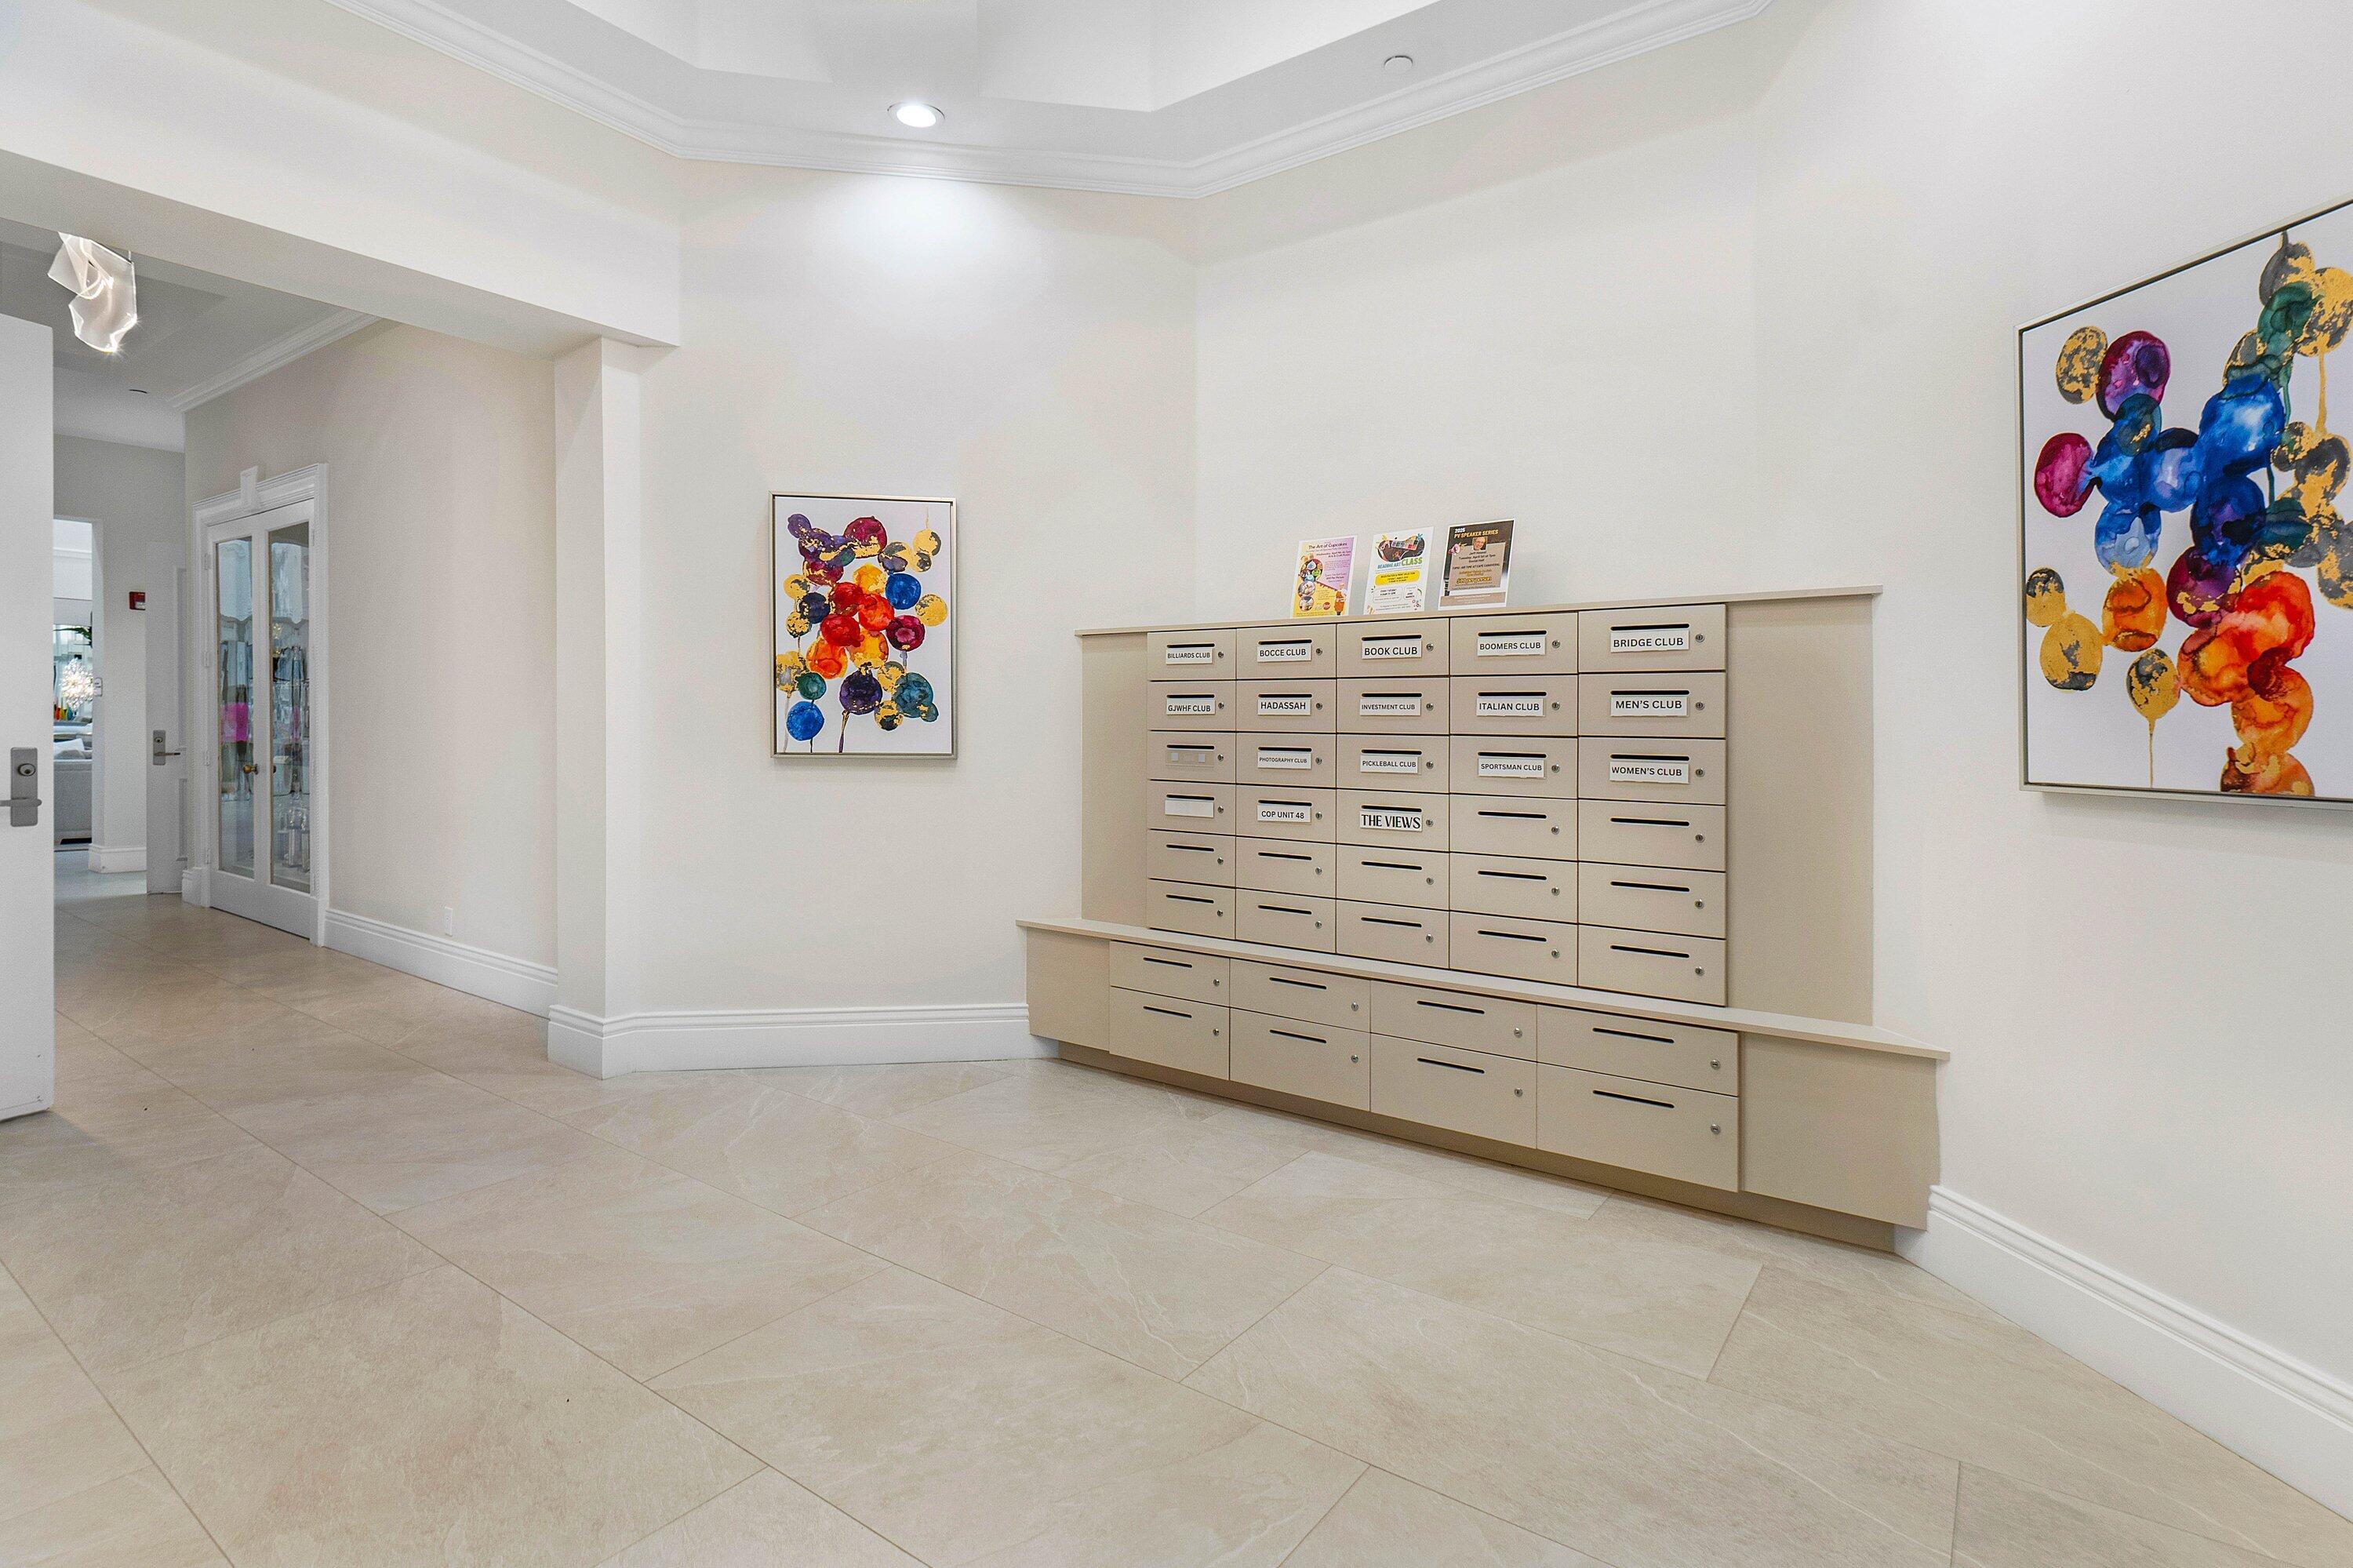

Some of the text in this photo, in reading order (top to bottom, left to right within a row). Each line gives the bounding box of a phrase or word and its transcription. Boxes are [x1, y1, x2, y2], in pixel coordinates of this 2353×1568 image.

[1402, 557, 1423, 566] CLASS
[1614, 638, 1652, 647] BRIDGE
[1362, 814, 1420, 830] THE VIEWS
